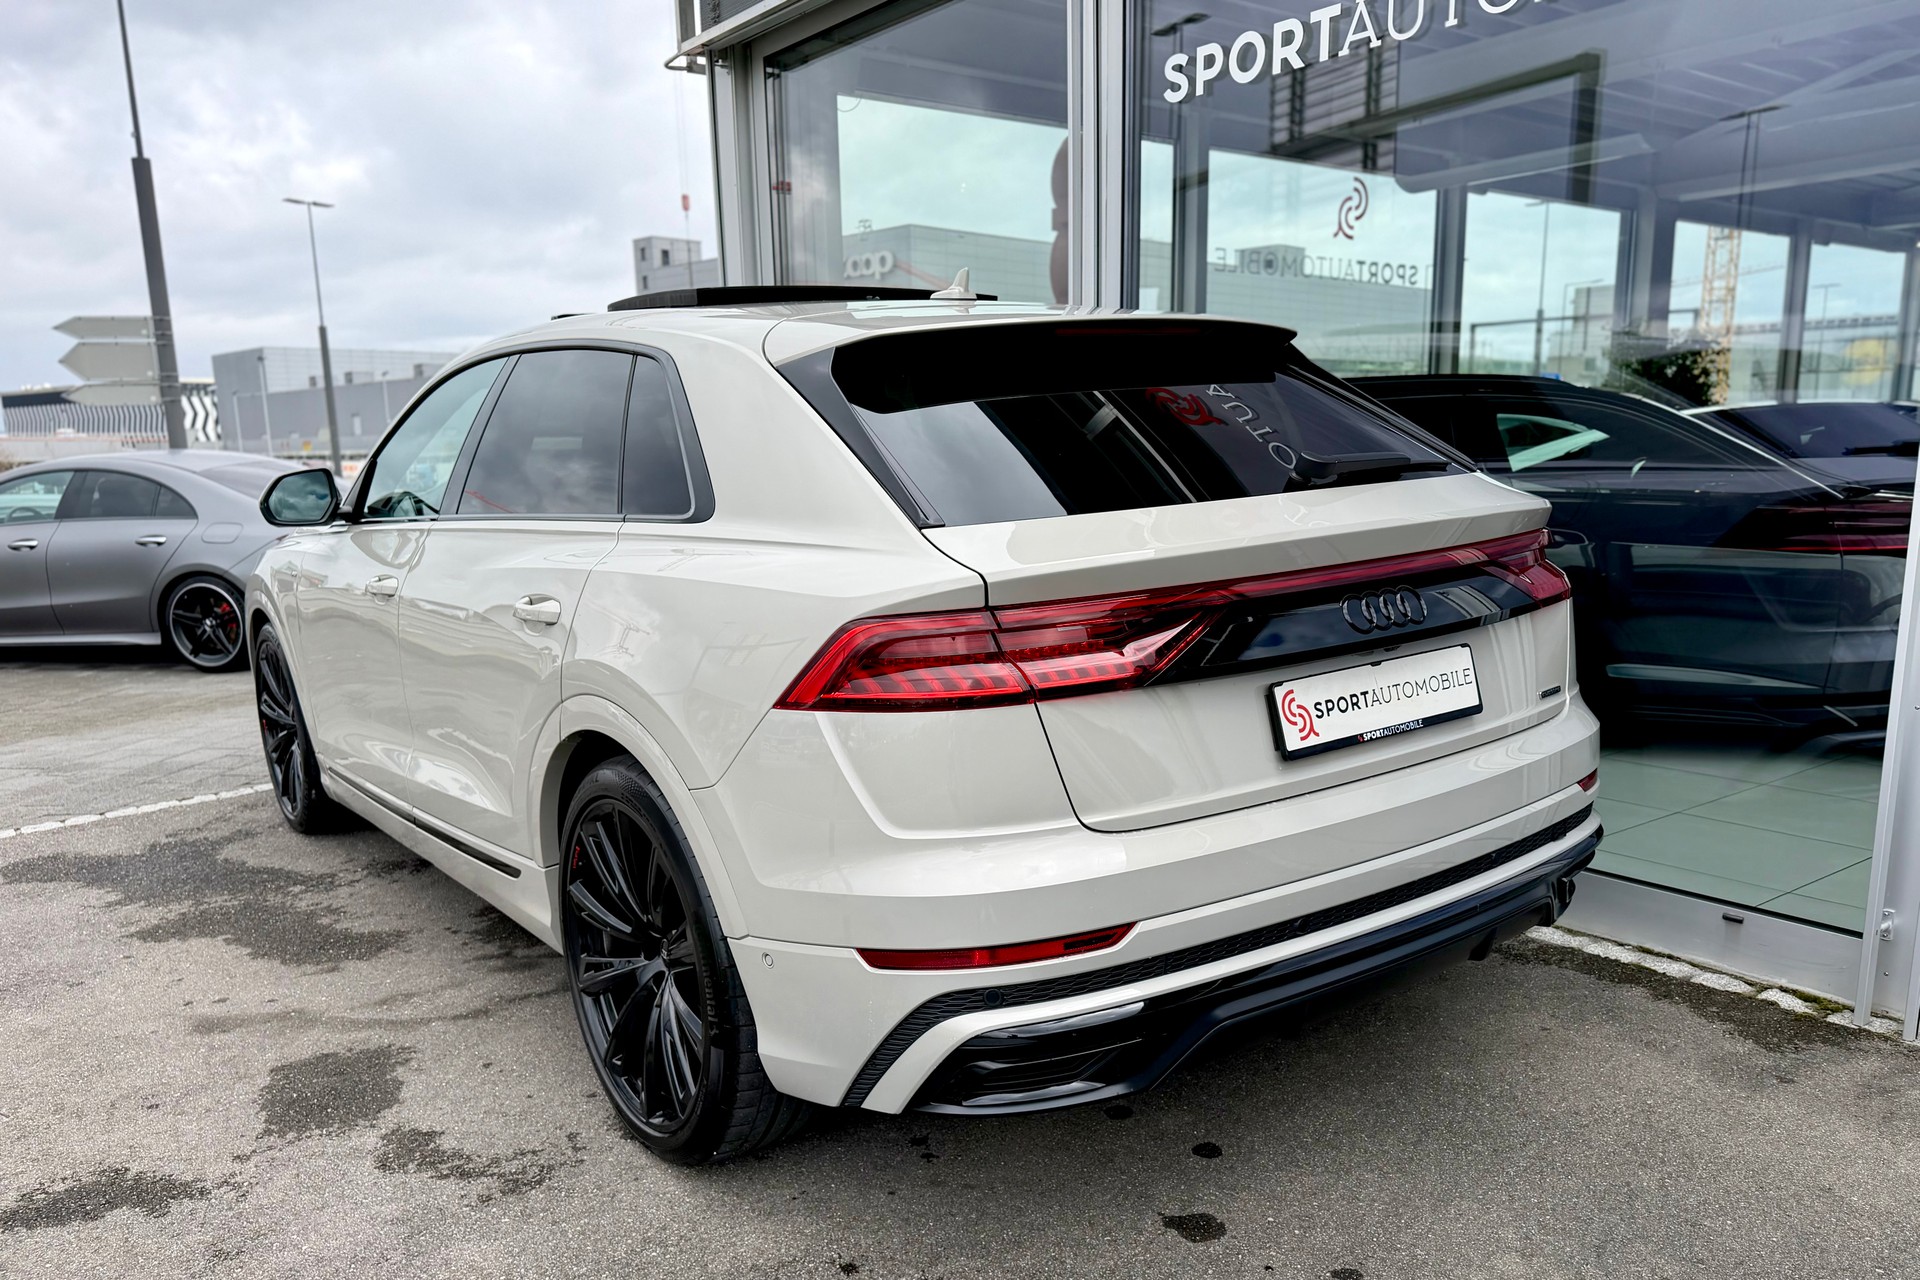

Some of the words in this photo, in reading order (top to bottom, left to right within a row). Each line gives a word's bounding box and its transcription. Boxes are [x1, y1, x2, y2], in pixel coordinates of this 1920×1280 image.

[1163, 0, 1542, 103] SPORTAU
[844, 250, 894, 281] oop
[1313, 667, 1473, 720] SPORTAUTOMOBILE
[1363, 719, 1424, 742] SPORTAUTOMOBILE
